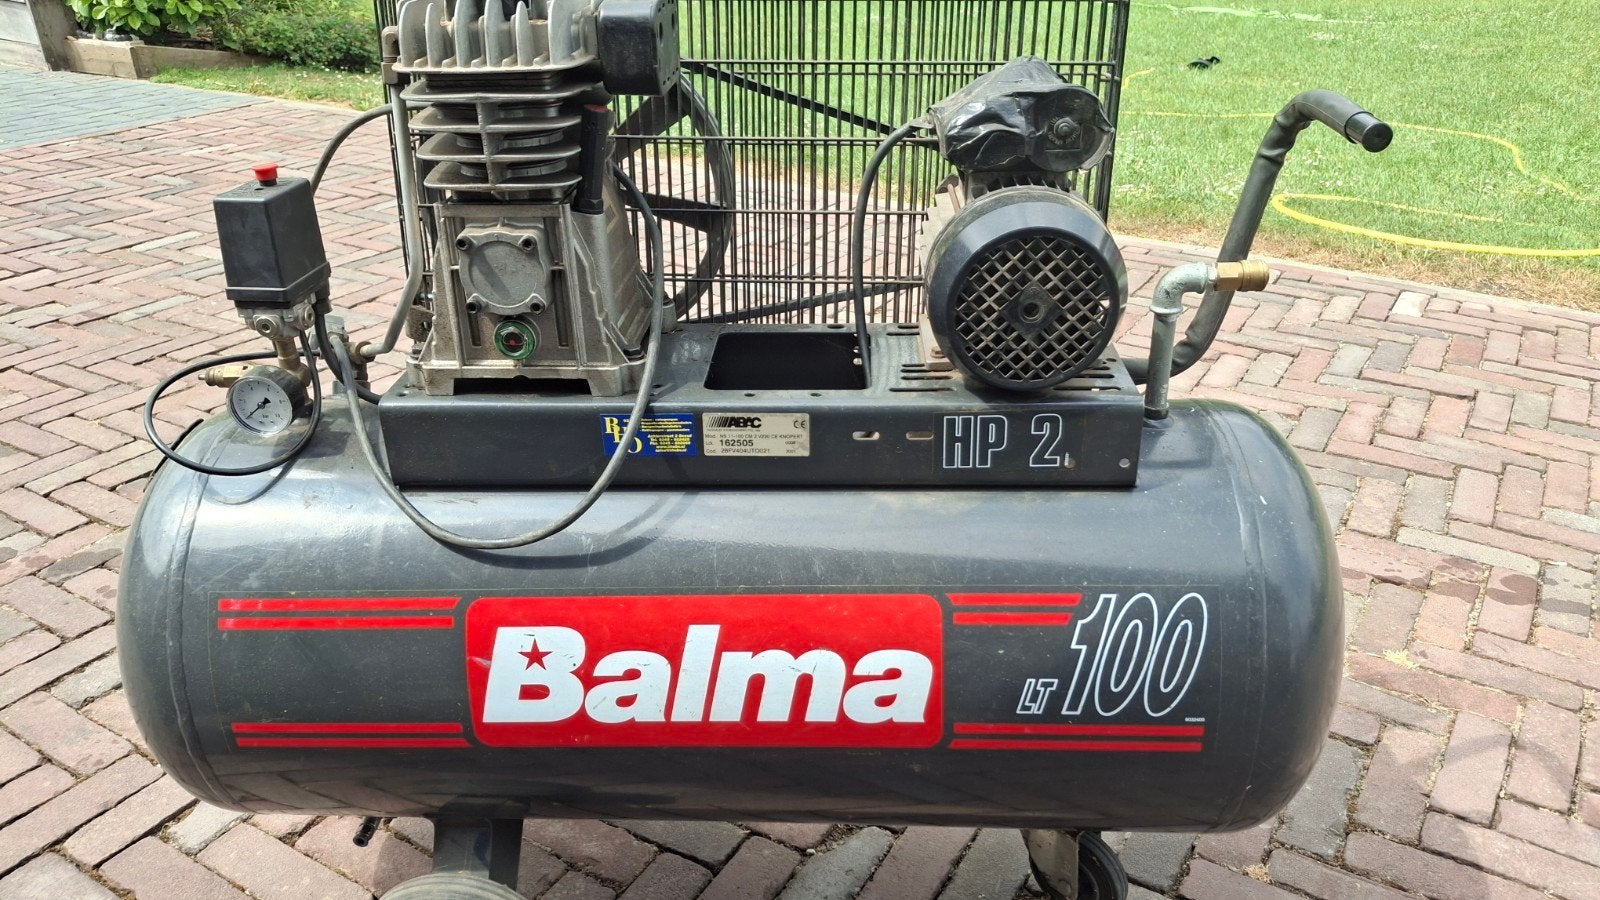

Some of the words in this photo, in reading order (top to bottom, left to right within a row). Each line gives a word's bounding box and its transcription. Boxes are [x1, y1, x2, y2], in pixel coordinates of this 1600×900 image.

[719, 439, 754, 447] 162505
[727, 416, 762, 428] ABAC
[942, 415, 1008, 469] HP
[1029, 413, 1063, 468] 2
[482, 623, 934, 724] Balma
[1016, 678, 1059, 715] LT
[1061, 592, 1208, 718] 100
